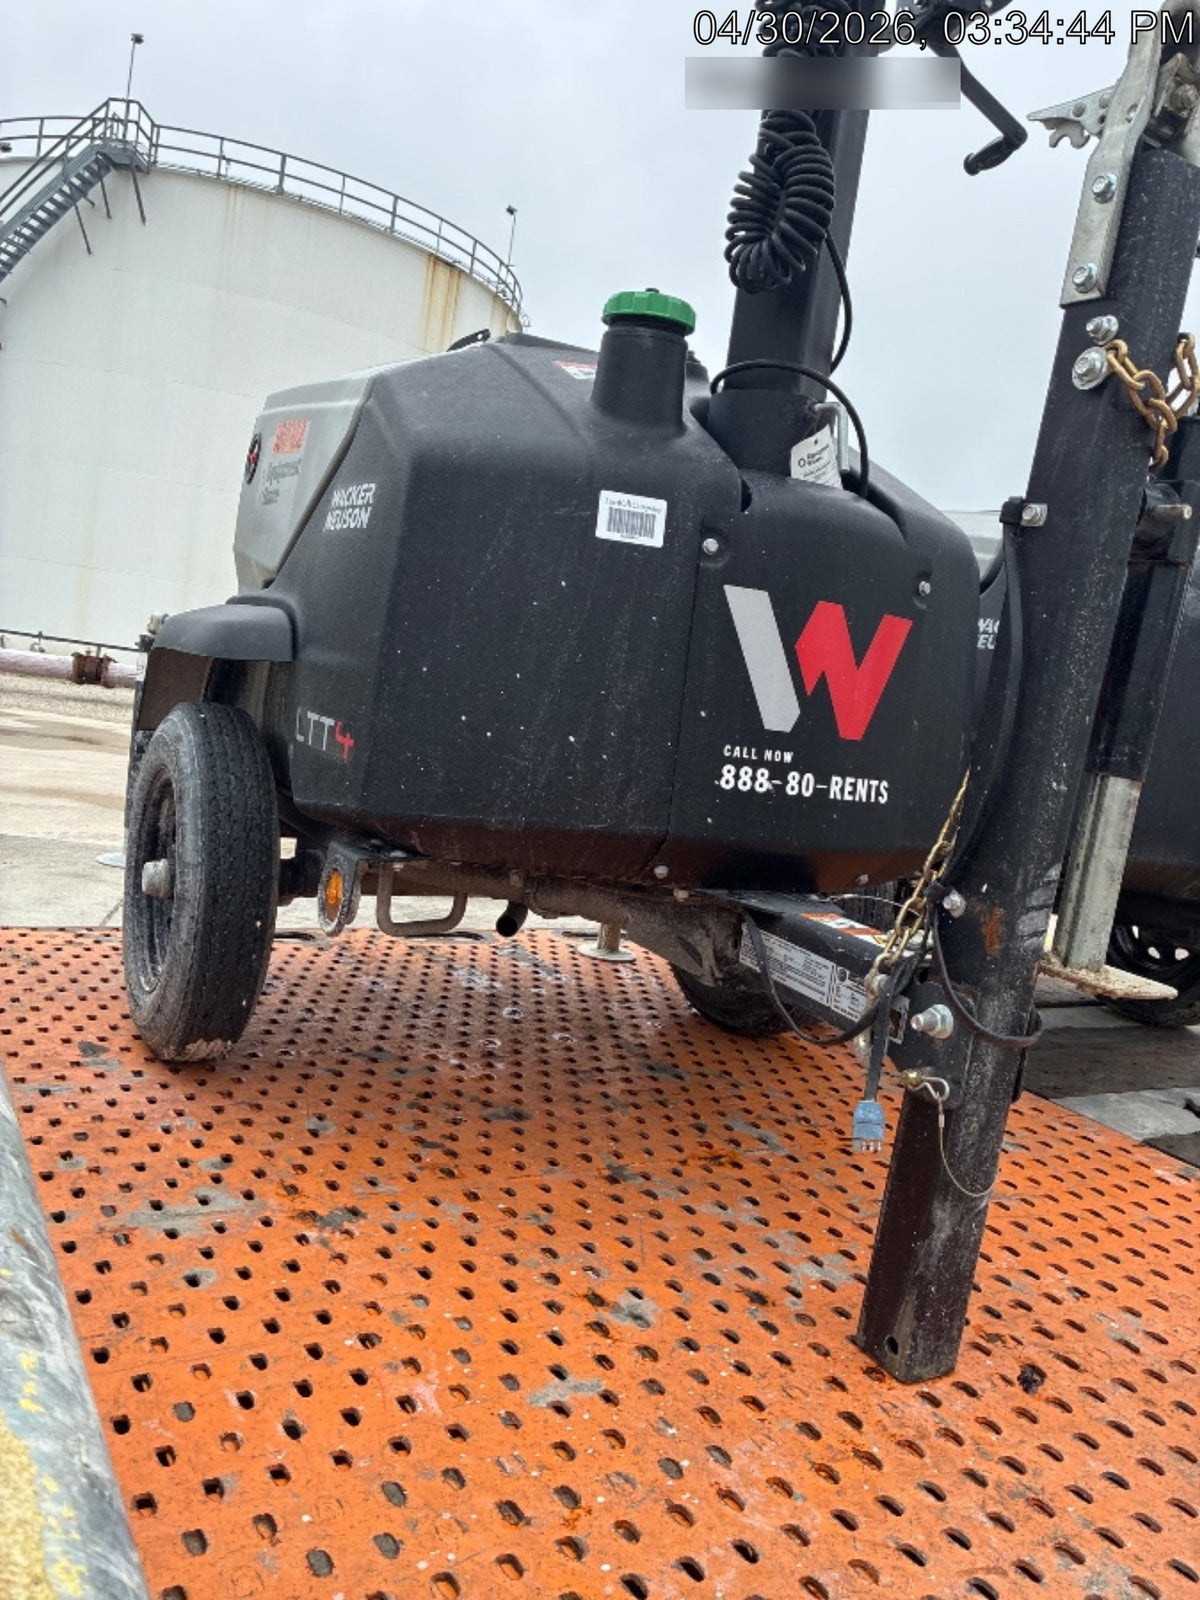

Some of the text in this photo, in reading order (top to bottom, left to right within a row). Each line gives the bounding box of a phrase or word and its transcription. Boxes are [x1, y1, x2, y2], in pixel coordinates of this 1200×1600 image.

[331, 483, 376, 507] WACKER
[323, 506, 372, 532] NEUSON
[723, 744, 794, 763] CALL NOW
[720, 764, 889, 804] 888-80-RENTS
